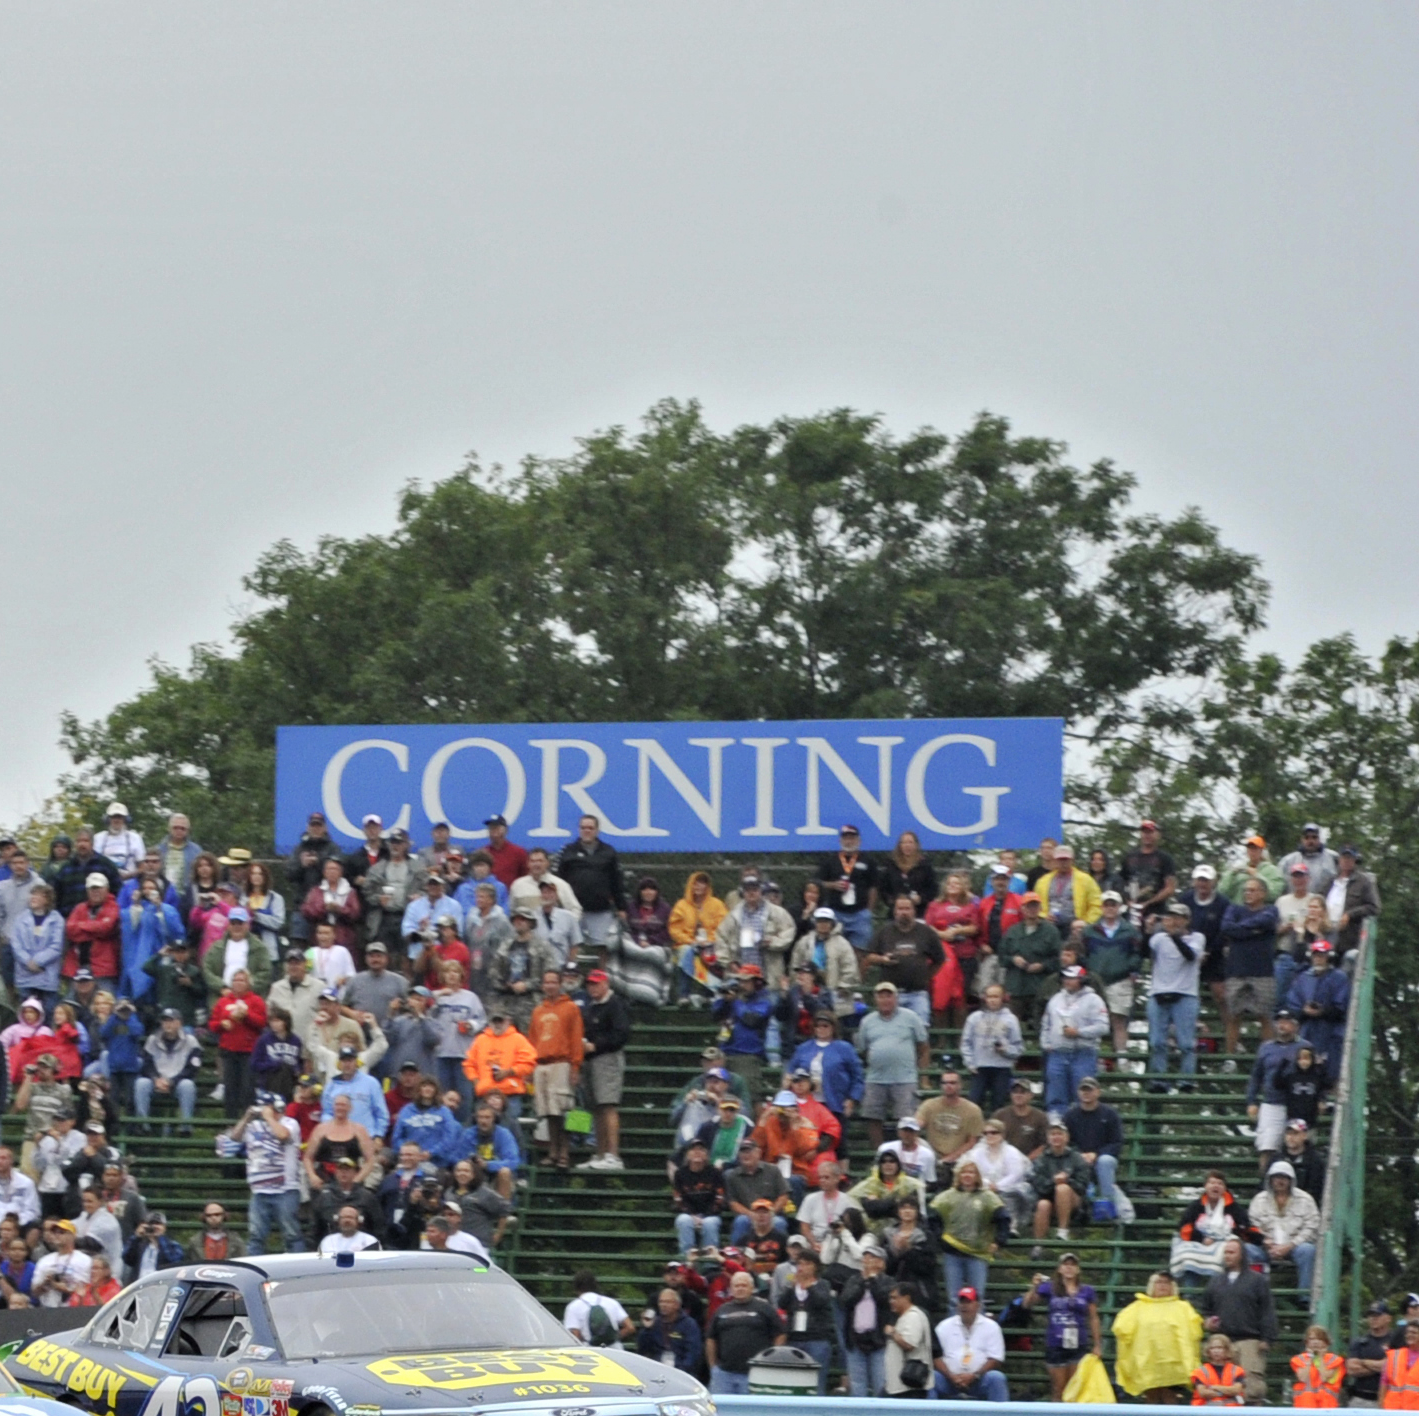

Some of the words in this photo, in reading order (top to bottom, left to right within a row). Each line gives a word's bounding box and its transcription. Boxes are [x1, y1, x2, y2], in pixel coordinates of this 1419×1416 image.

[321, 733, 1011, 839] CORNING
[392, 1350, 600, 1370] BEST
[16, 1339, 81, 1382] BEST
[68, 1358, 127, 1408] BUY
[419, 1362, 600, 1383] BUY
[513, 1384, 590, 1397] #1036
